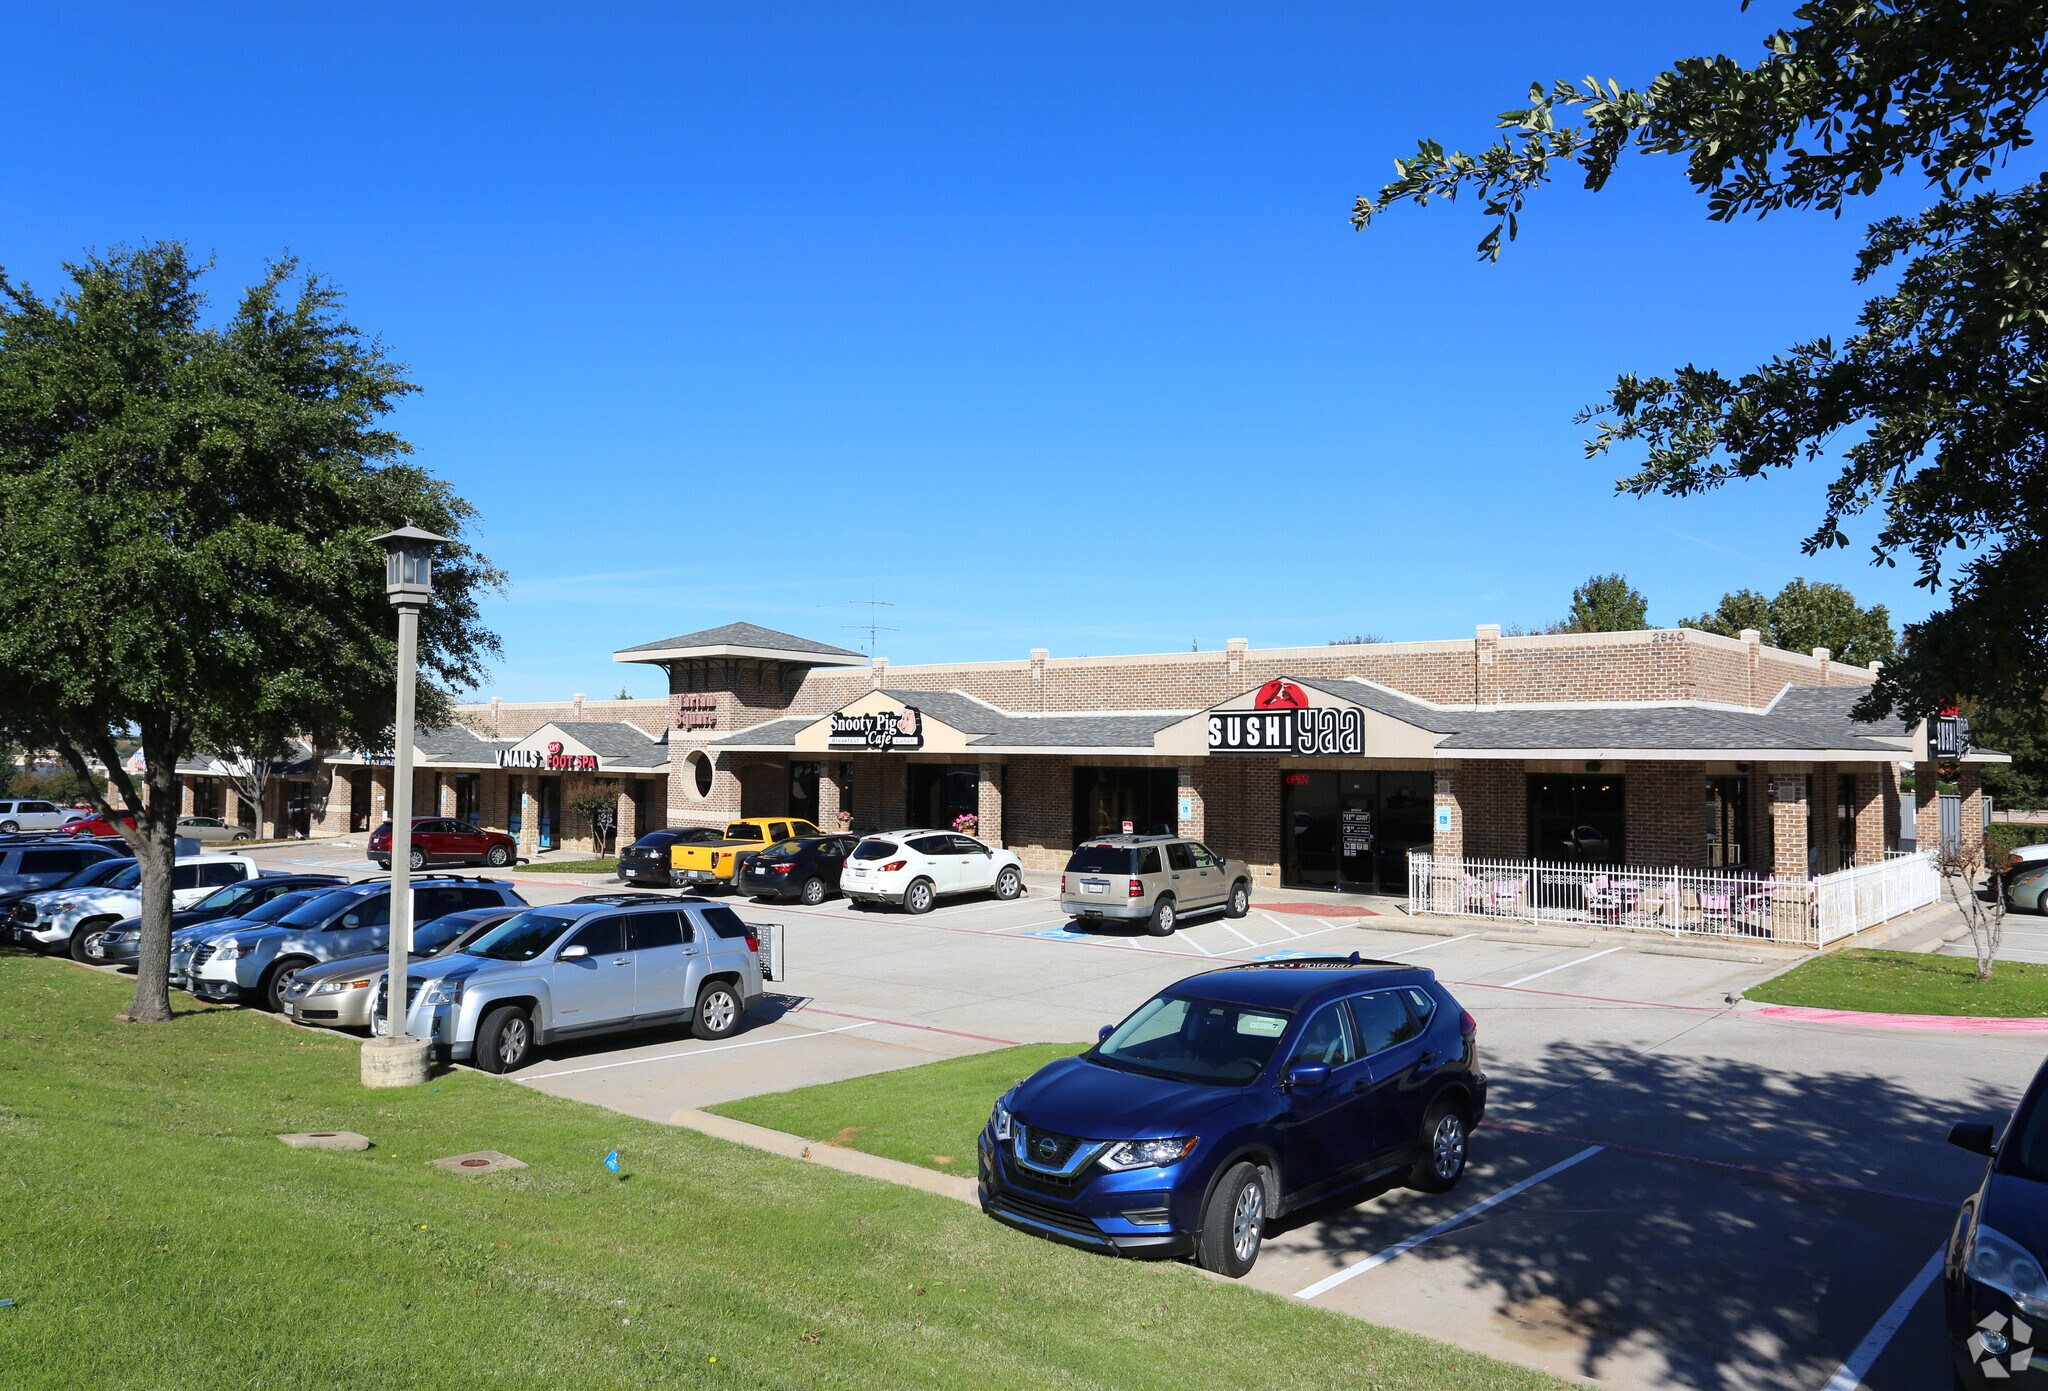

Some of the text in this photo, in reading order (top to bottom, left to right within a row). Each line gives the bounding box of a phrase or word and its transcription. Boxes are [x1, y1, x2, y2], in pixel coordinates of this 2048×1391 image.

[678, 694, 716, 707] Tartan
[676, 712, 717, 729] Square
[831, 714, 897, 735] Snooty Pig
[868, 731, 891, 747] Cafe
[1208, 709, 1361, 754] SUSHI yaa
[503, 750, 538, 768] NAILS
[547, 755, 595, 769] FOOT SPA
[1286, 774, 1309, 785] OPEN
